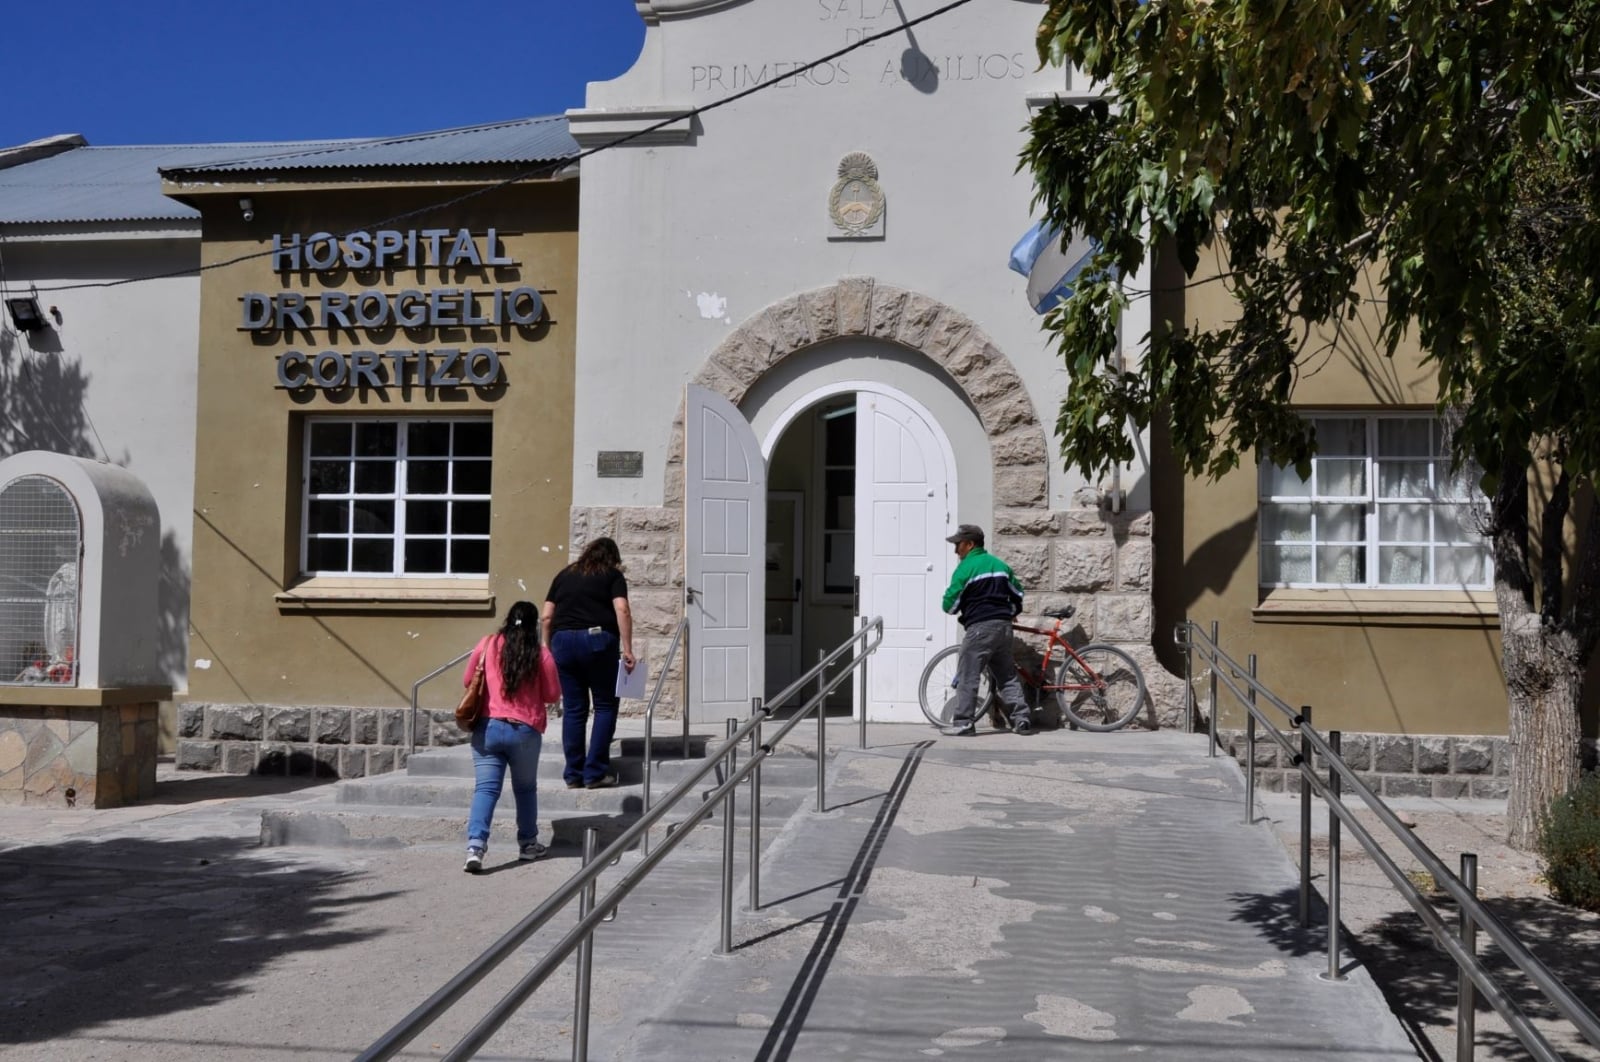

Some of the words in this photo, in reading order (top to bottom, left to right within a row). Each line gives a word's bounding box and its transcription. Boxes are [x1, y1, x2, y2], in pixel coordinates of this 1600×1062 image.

[818, 0, 900, 21] SALA
[846, 27, 876, 47] DE
[690, 59, 850, 91] PRIMEROS
[879, 52, 1025, 84] AUXILIOS
[272, 228, 513, 271] HOSPITAL
[243, 292, 309, 330] DR
[320, 286, 543, 329] ROGELIO
[276, 347, 500, 389] CORTIZO
